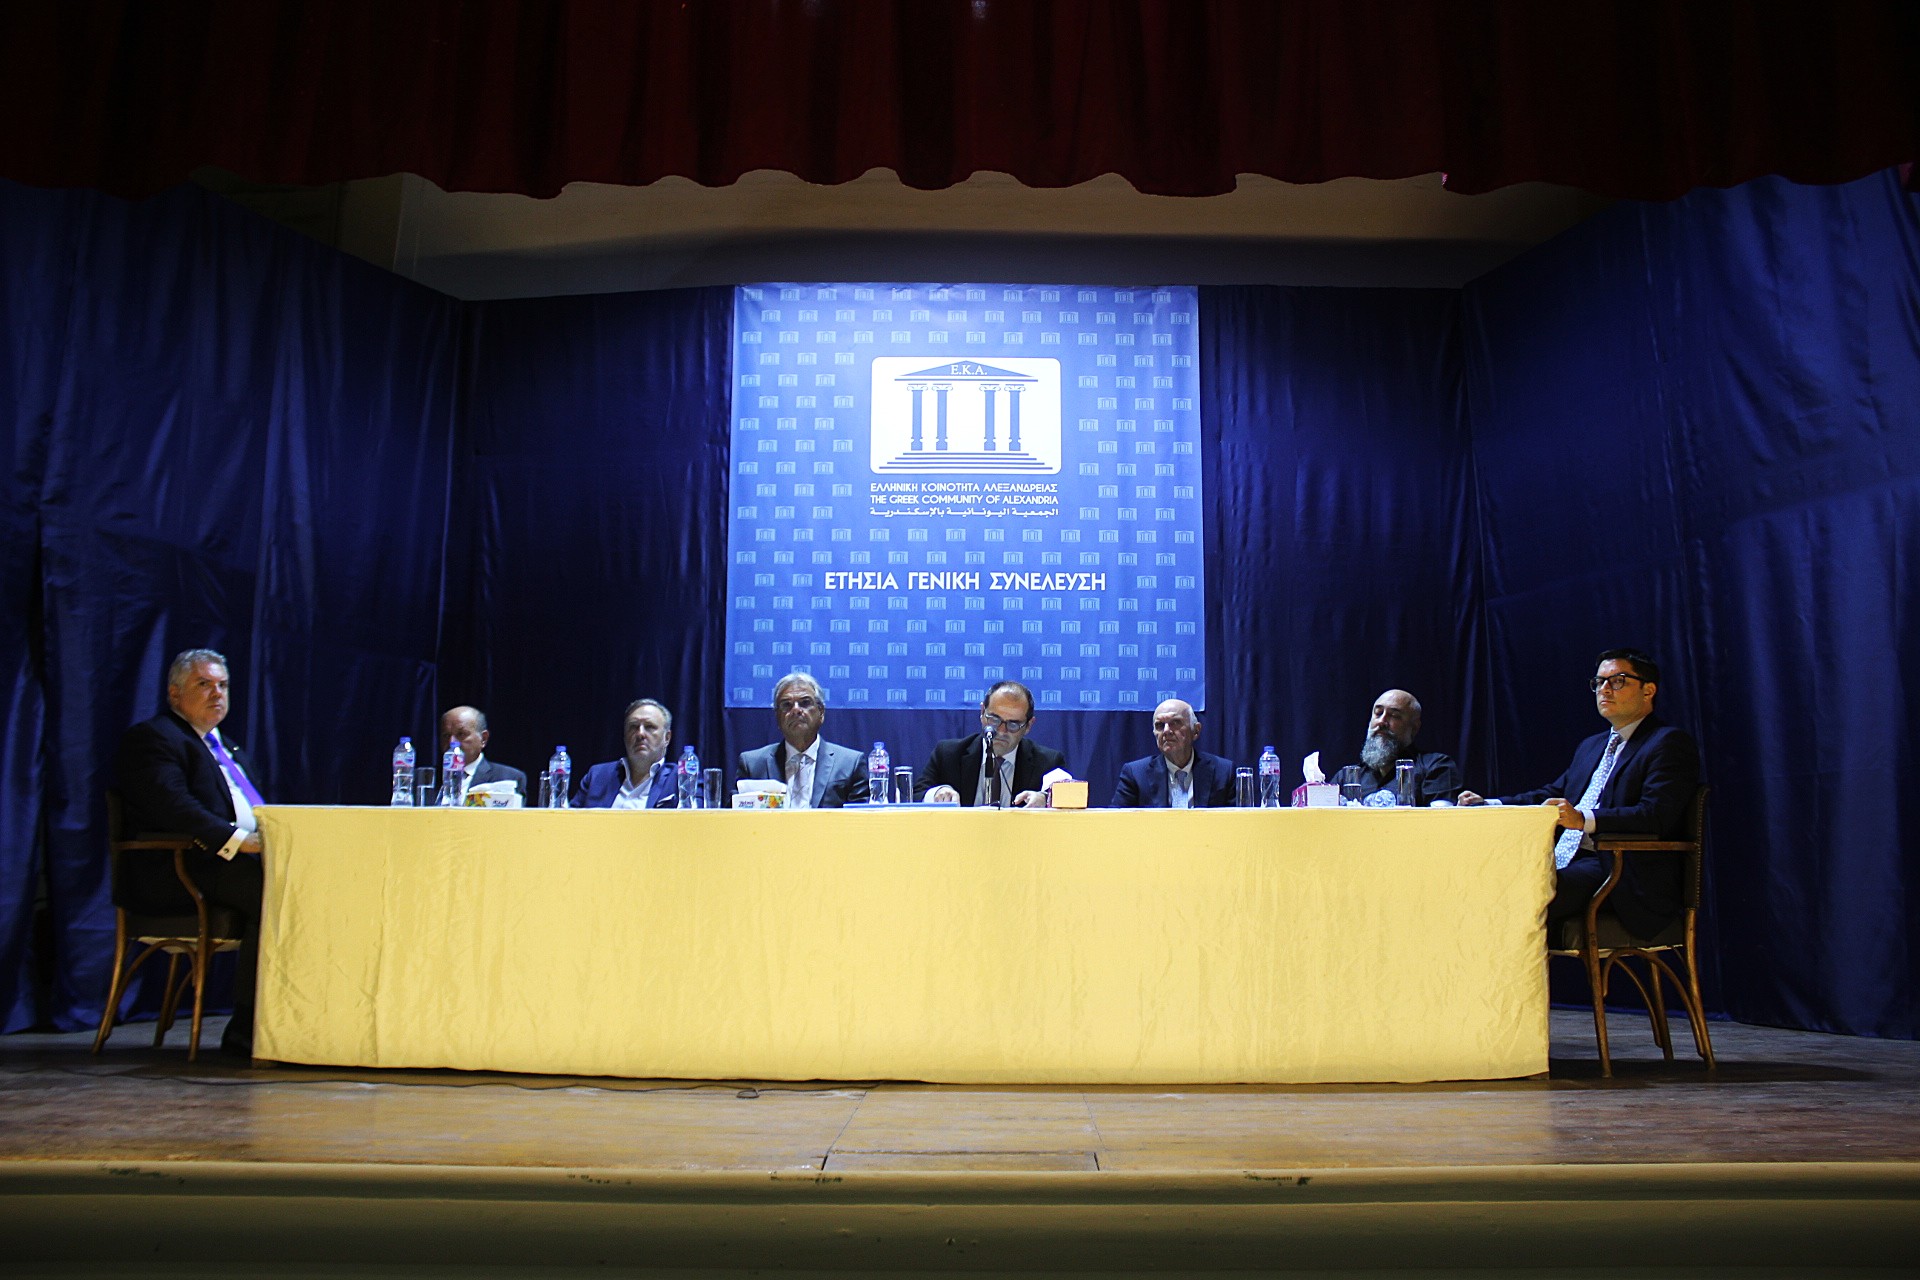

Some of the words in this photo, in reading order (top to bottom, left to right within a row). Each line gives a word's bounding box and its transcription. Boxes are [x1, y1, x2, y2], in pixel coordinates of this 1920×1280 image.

[870, 482, 918, 492] ΕΛΛΗΝΙΚΗ
[921, 482, 980, 492] ΚΟΙΝΟΤΗΤΑ
[983, 483, 1058, 493] ΑΛΕΞΑΝΔΡΕΙΑΣ
[870, 494, 887, 504] THE
[889, 494, 919, 504] GREEK
[921, 494, 983, 504] COMMUNITY
[985, 494, 1001, 504] OF
[1002, 495, 1059, 505] ALEXANDRIA
[824, 571, 899, 590] ΕΤΗΣΙΑ
[907, 571, 980, 590] ΓΕΝΙΚΗ
[989, 572, 1106, 591] ΣΥΝΕΛΕΥΣΗ
